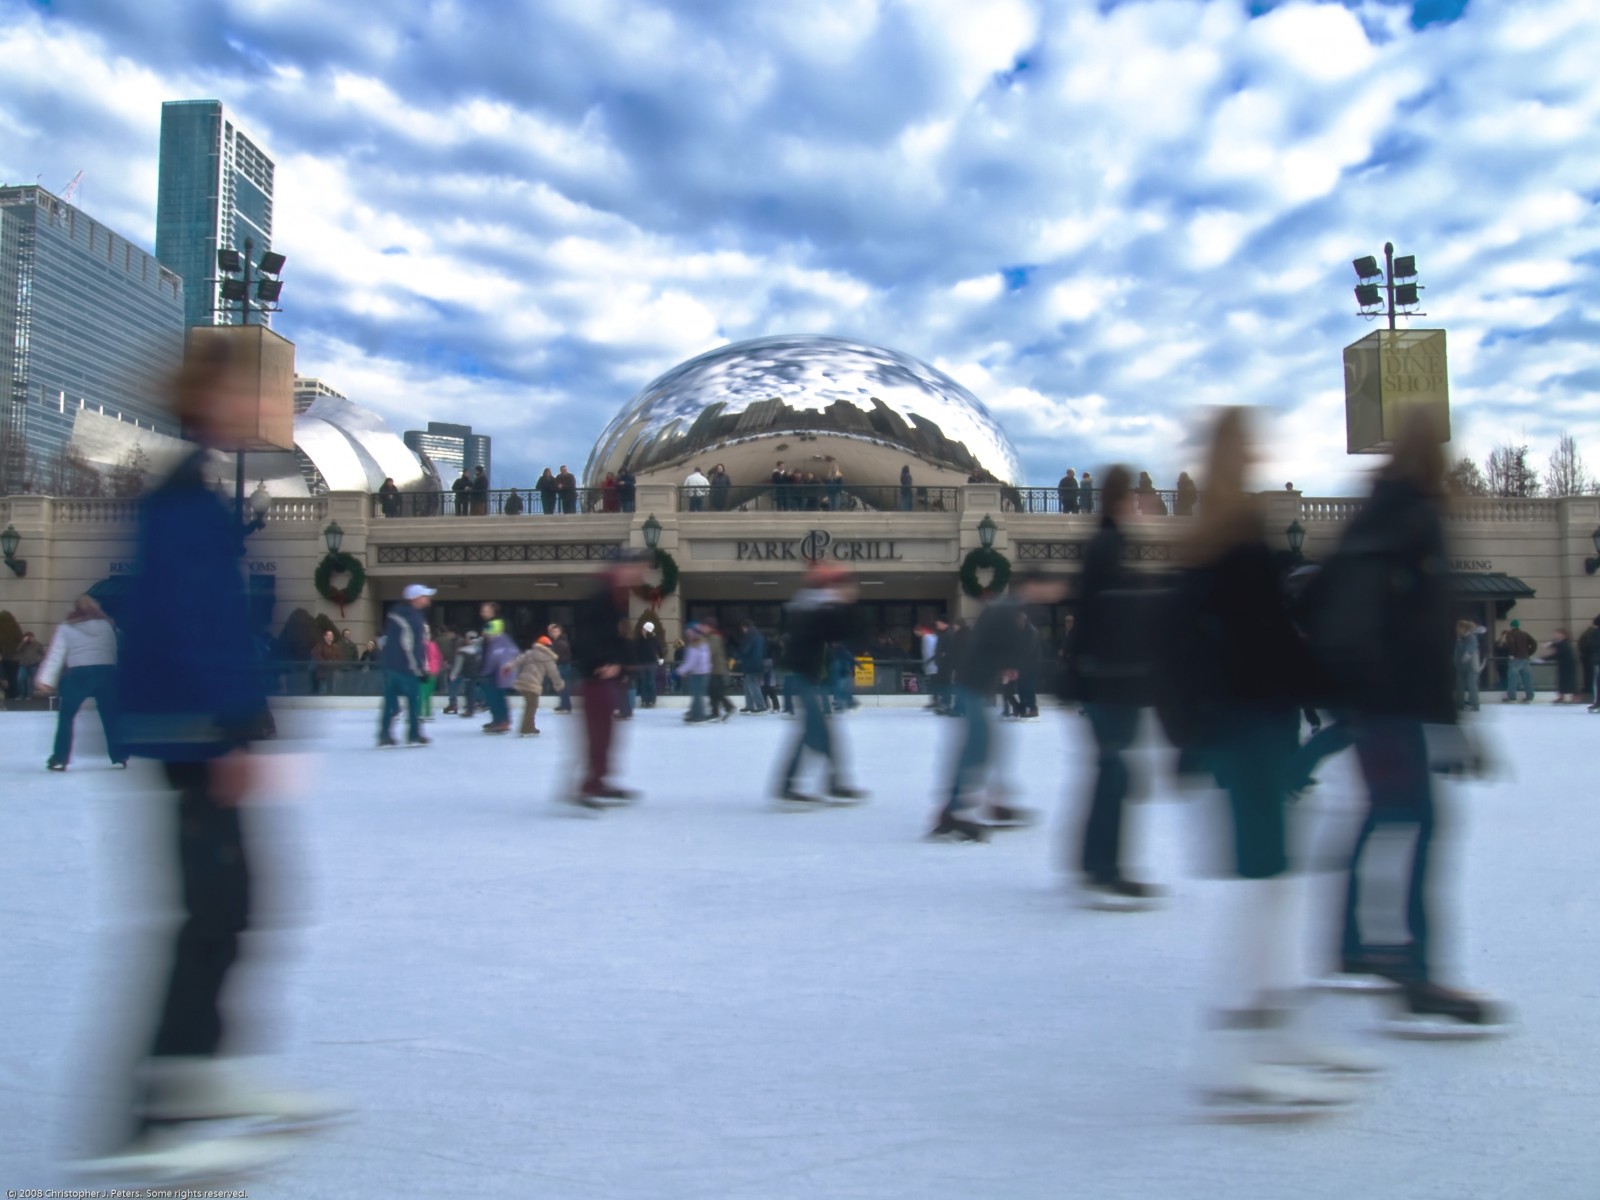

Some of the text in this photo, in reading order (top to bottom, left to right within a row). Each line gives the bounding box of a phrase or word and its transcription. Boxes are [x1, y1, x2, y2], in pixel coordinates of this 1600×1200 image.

[1386, 356, 1442, 374] DINE
[1384, 375, 1443, 392] SHOP
[735, 541, 796, 560] PARK
[833, 541, 903, 560] GRILL
[1447, 559, 1493, 570] ARKING
